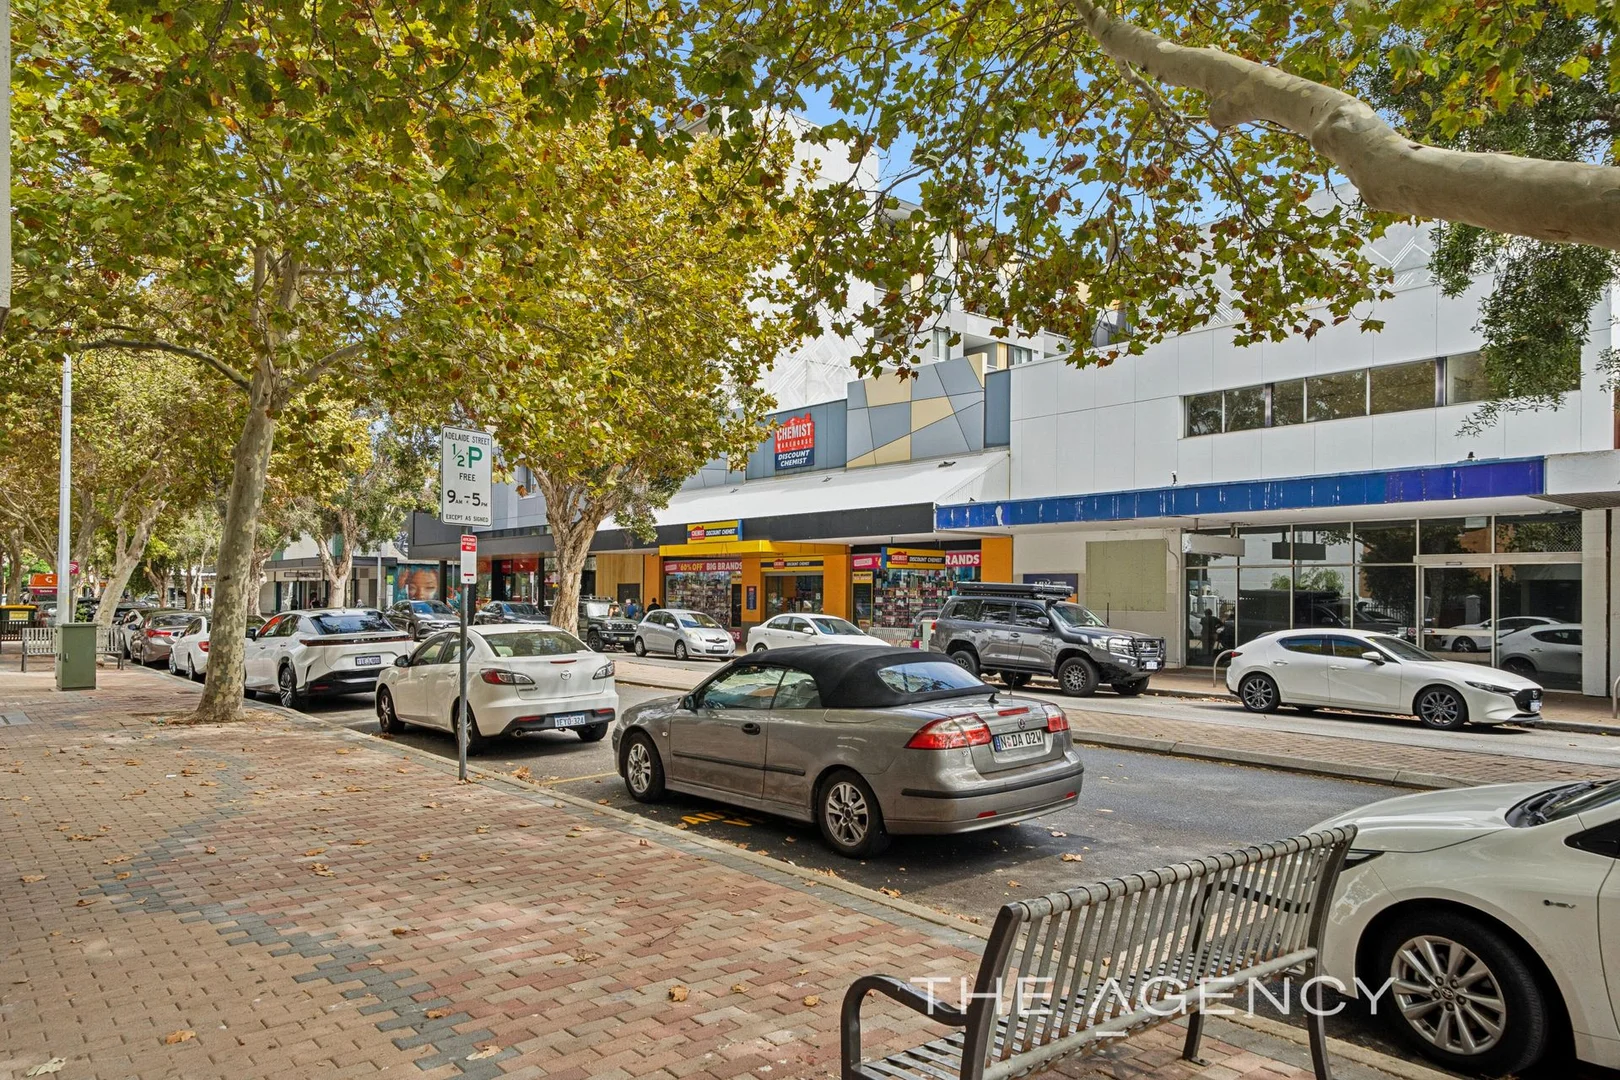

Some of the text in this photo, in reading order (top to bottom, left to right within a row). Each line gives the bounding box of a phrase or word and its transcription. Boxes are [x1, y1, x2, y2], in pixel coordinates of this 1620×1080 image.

[776, 422, 812, 442] CHEMIST
[445, 432, 490, 446] ADELAIDE STREET
[777, 437, 812, 449] WAREHOUSE
[778, 449, 810, 460] DISCOUNT
[780, 457, 807, 467] CHEMIST
[459, 472, 476, 482] FREE
[945, 554, 980, 565] RANDS
[706, 562, 717, 571] BIG
[718, 561, 742, 570] BRANDS
